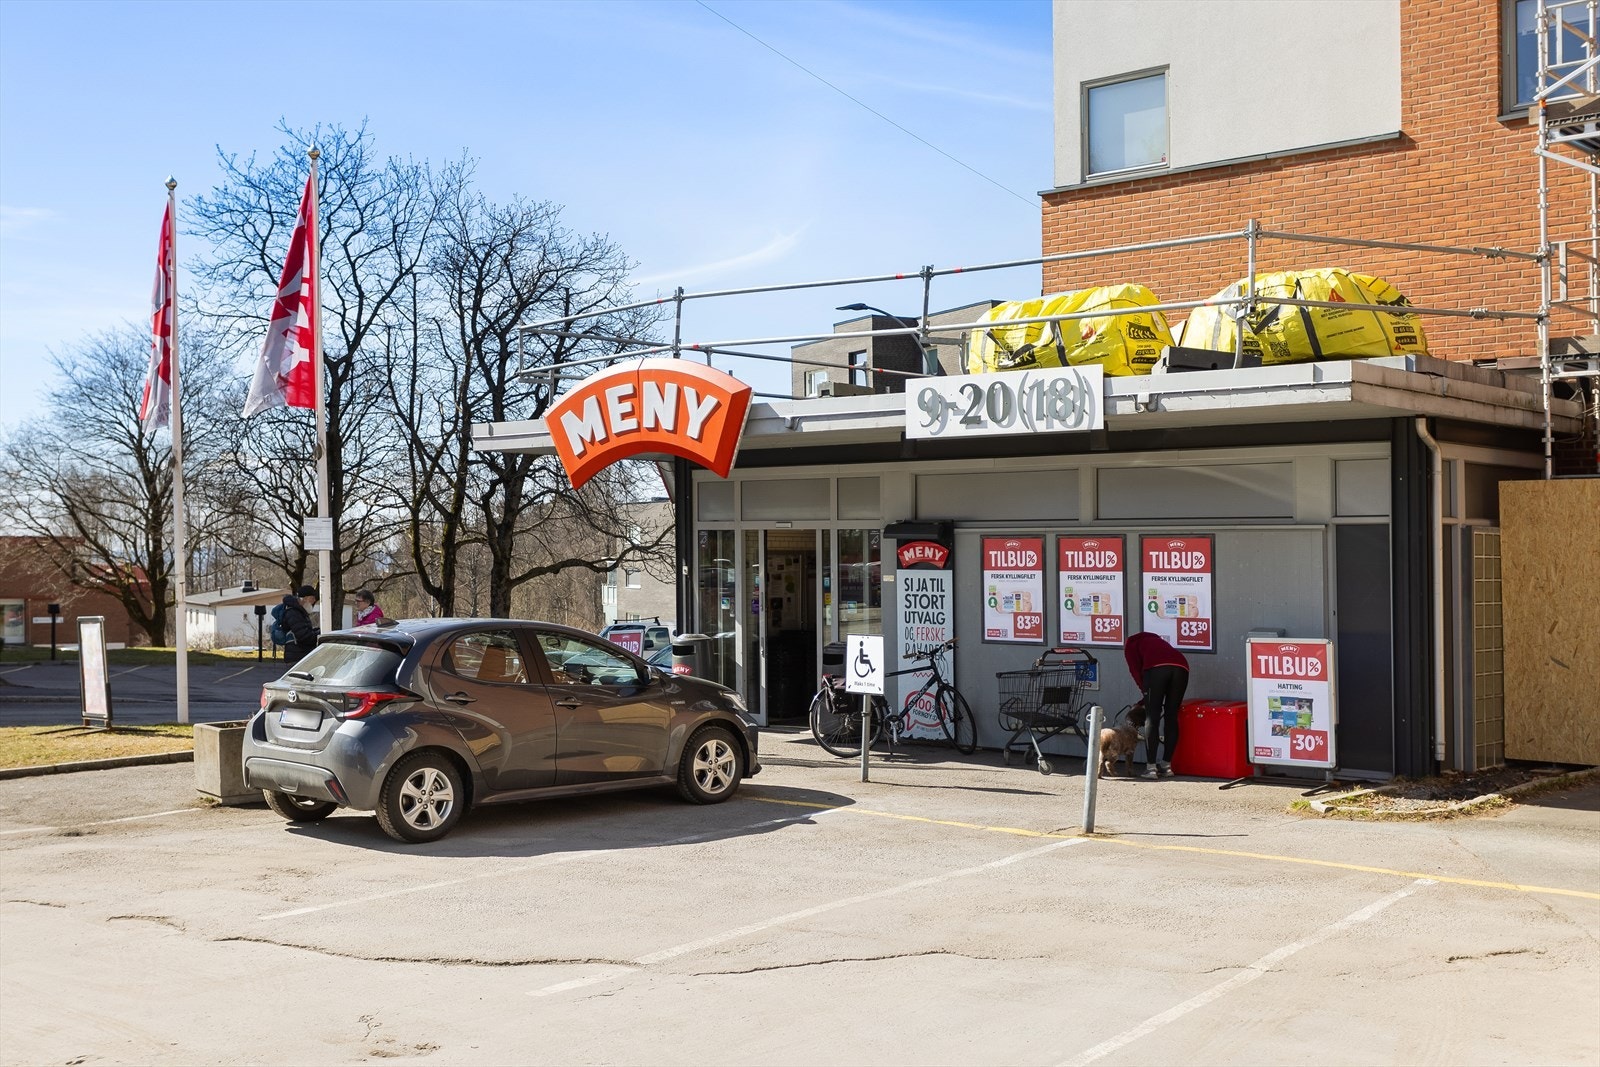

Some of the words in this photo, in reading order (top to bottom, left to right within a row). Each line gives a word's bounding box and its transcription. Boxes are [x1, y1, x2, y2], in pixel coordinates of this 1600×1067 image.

[560, 381, 718, 456] MENY
[903, 546, 944, 561] MENY
[989, 550, 1038, 567] TILBUD
[1065, 550, 1118, 568] TILBUD
[1149, 551, 1205, 569] TILBUD
[904, 577, 913, 591] SI
[916, 577, 928, 592] JA
[930, 578, 945, 592] TIL
[1168, 575, 1203, 583] KYLLINGFILET
[904, 594, 945, 609] STORT
[904, 611, 945, 625] UTVALG
[904, 626, 914, 640] OG
[916, 626, 946, 642] FERSKE
[1257, 655, 1322, 677] TILBUD
[1292, 735, 1323, 751] -30%
